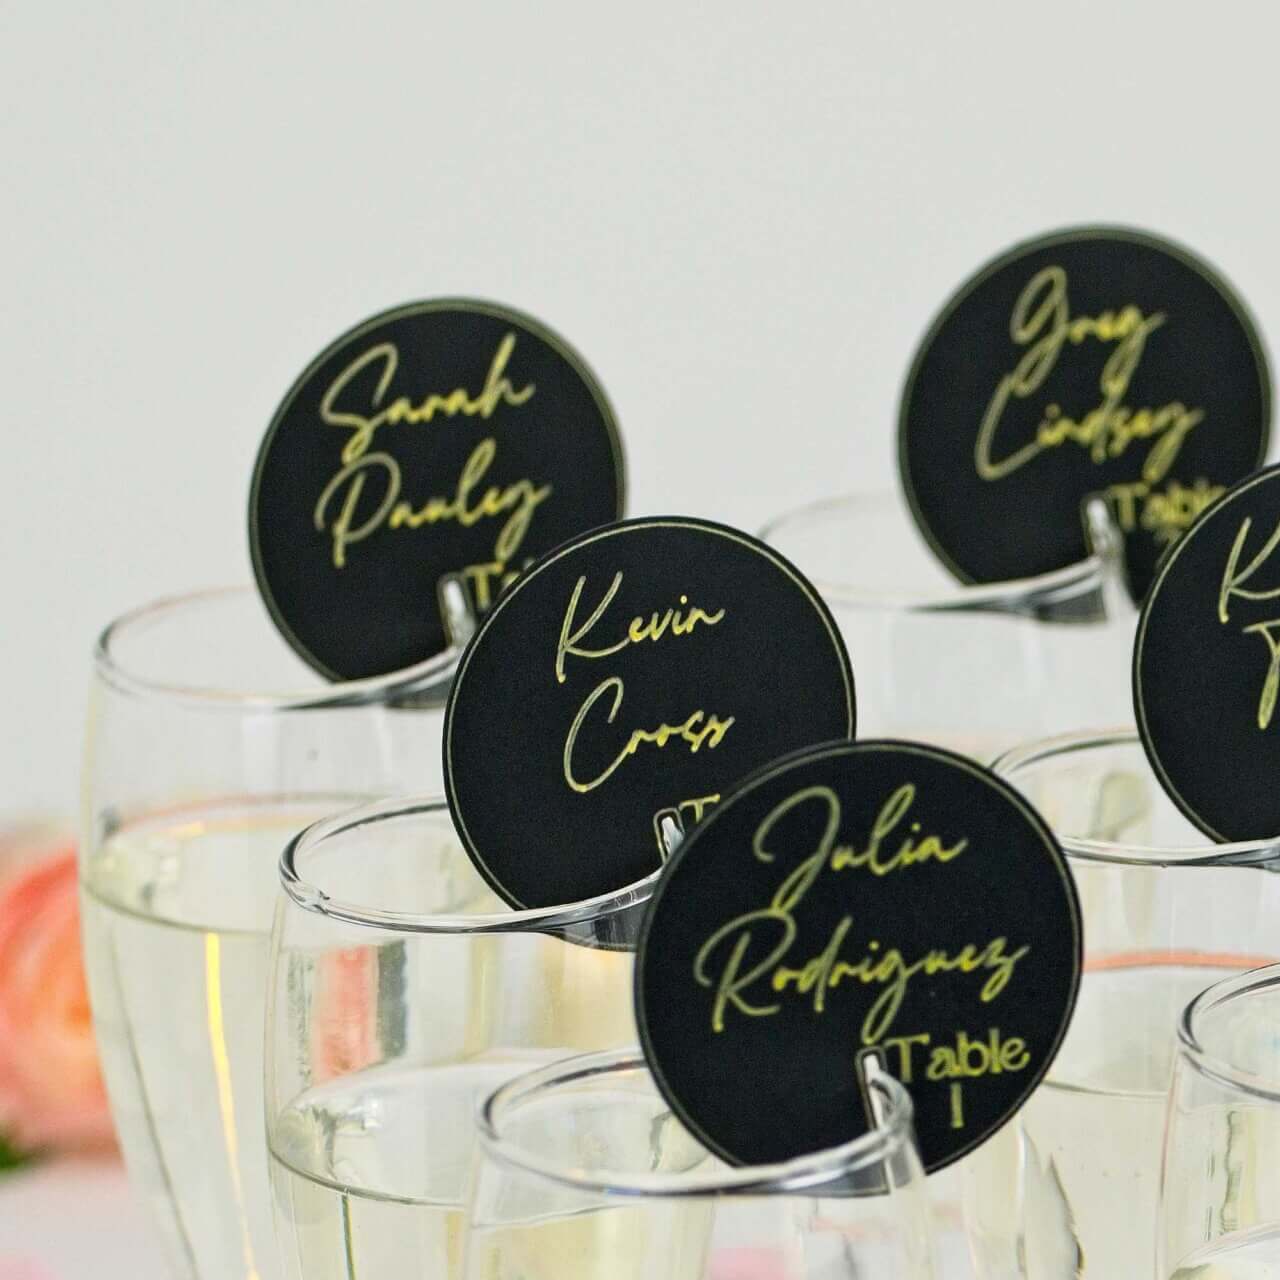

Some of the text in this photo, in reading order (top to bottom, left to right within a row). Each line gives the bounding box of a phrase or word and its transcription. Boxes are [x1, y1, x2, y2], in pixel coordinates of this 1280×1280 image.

[1010, 265, 1167, 397] Greg
[320, 332, 537, 465] Sarah
[555, 570, 726, 684] Kevin
[563, 676, 736, 794] Cross
[752, 783, 968, 914] Julia
[693, 908, 1030, 1046] Rodriguez
[884, 1027, 1031, 1083] Table
[950, 1083, 966, 1129] 1
